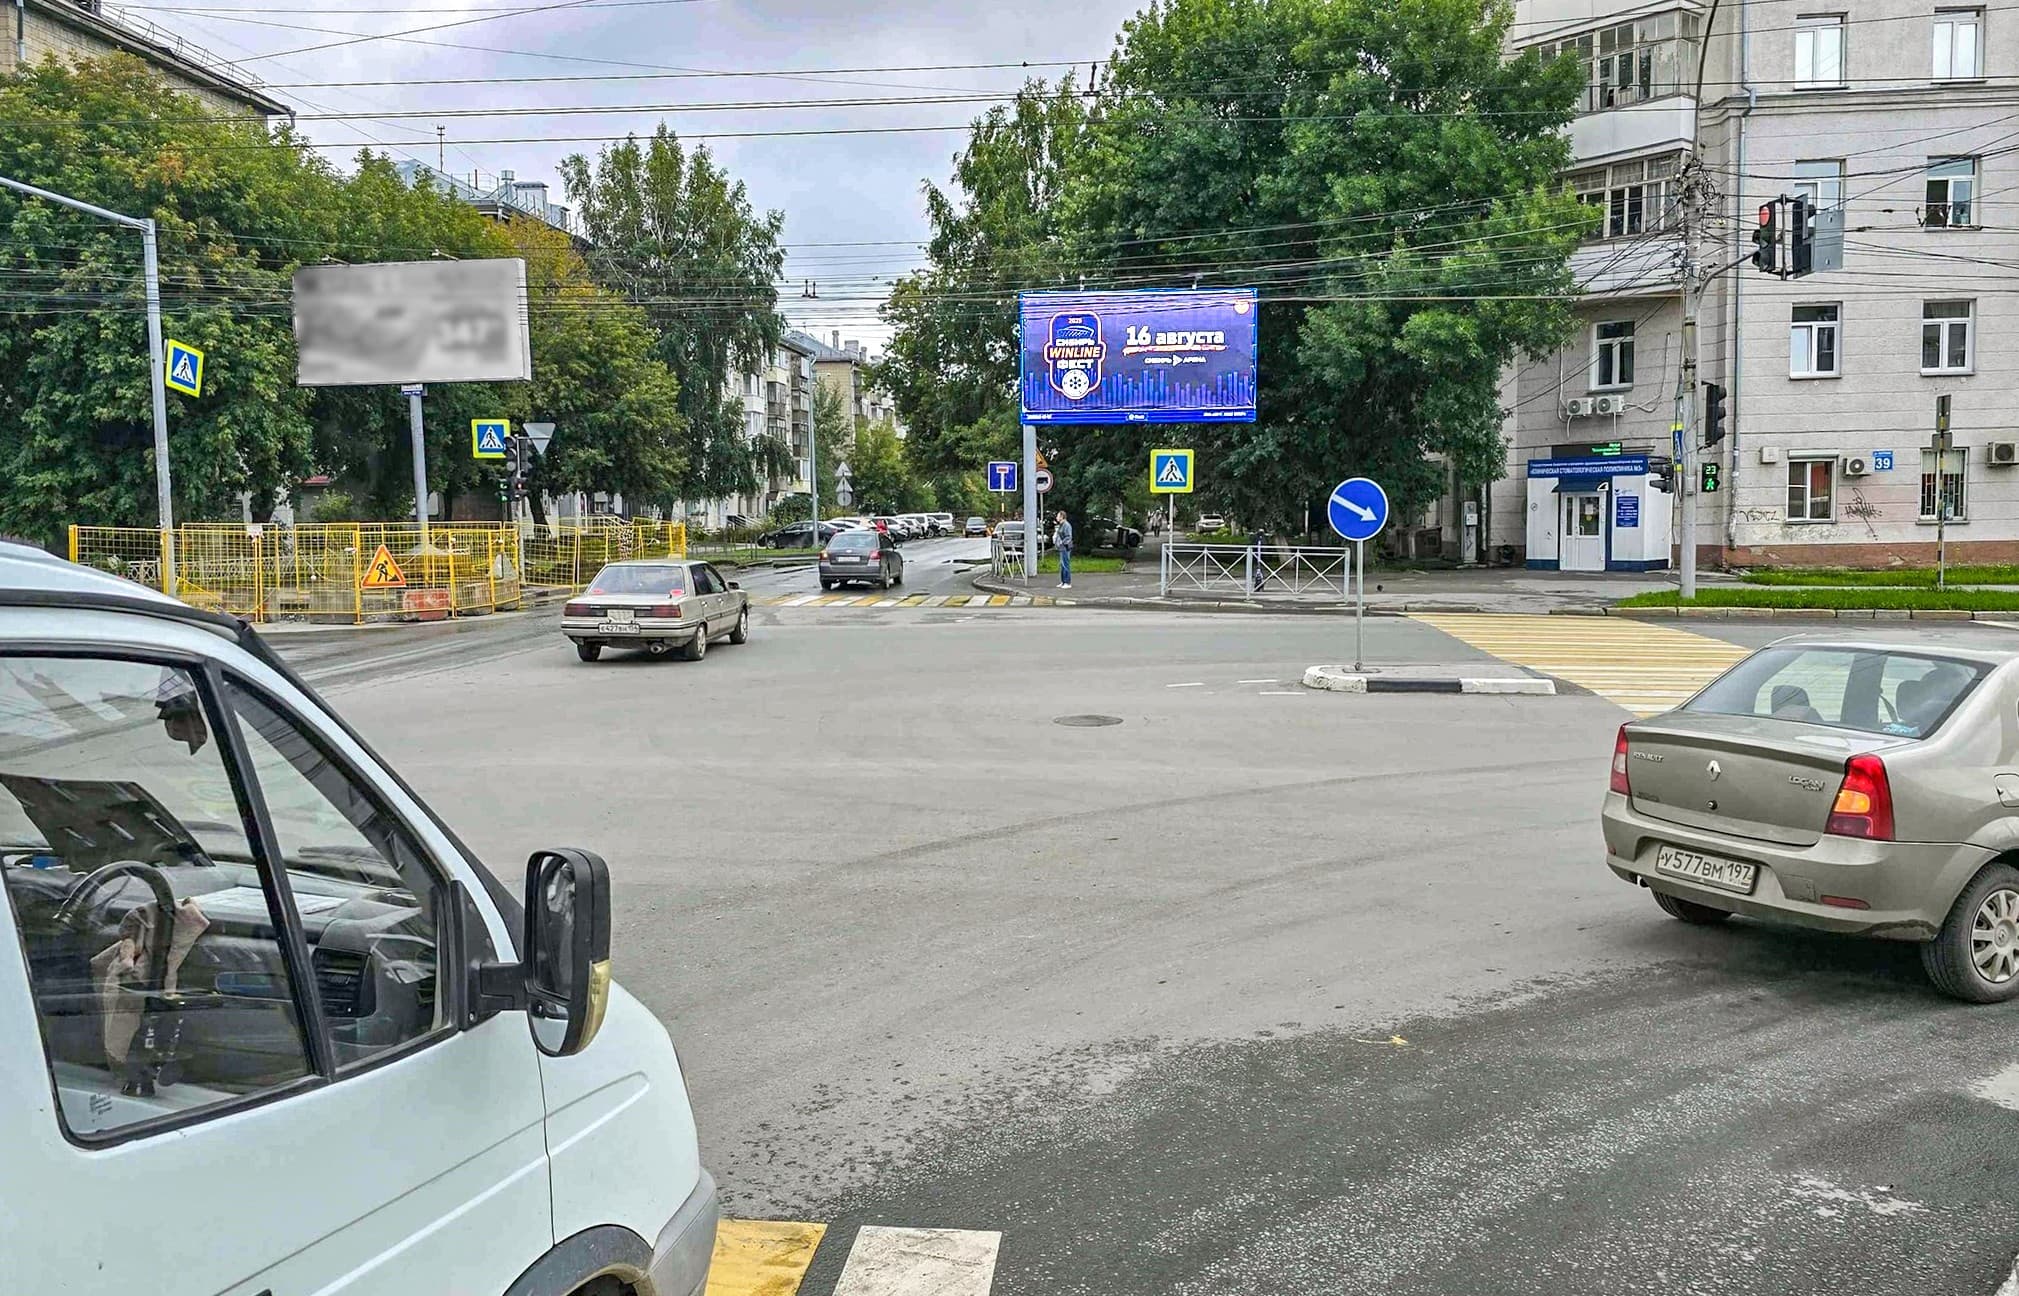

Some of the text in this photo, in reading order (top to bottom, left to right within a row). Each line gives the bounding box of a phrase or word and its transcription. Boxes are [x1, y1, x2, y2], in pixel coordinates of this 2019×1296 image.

[1126, 326, 1224, 347] 16 августа
[1050, 346, 1101, 358] WINLINE
[1876, 457, 1890, 469] 39
[1706, 465, 1716, 474] 23
[1789, 775, 1825, 788] LOGAN
[1727, 863, 1751, 880] 197
